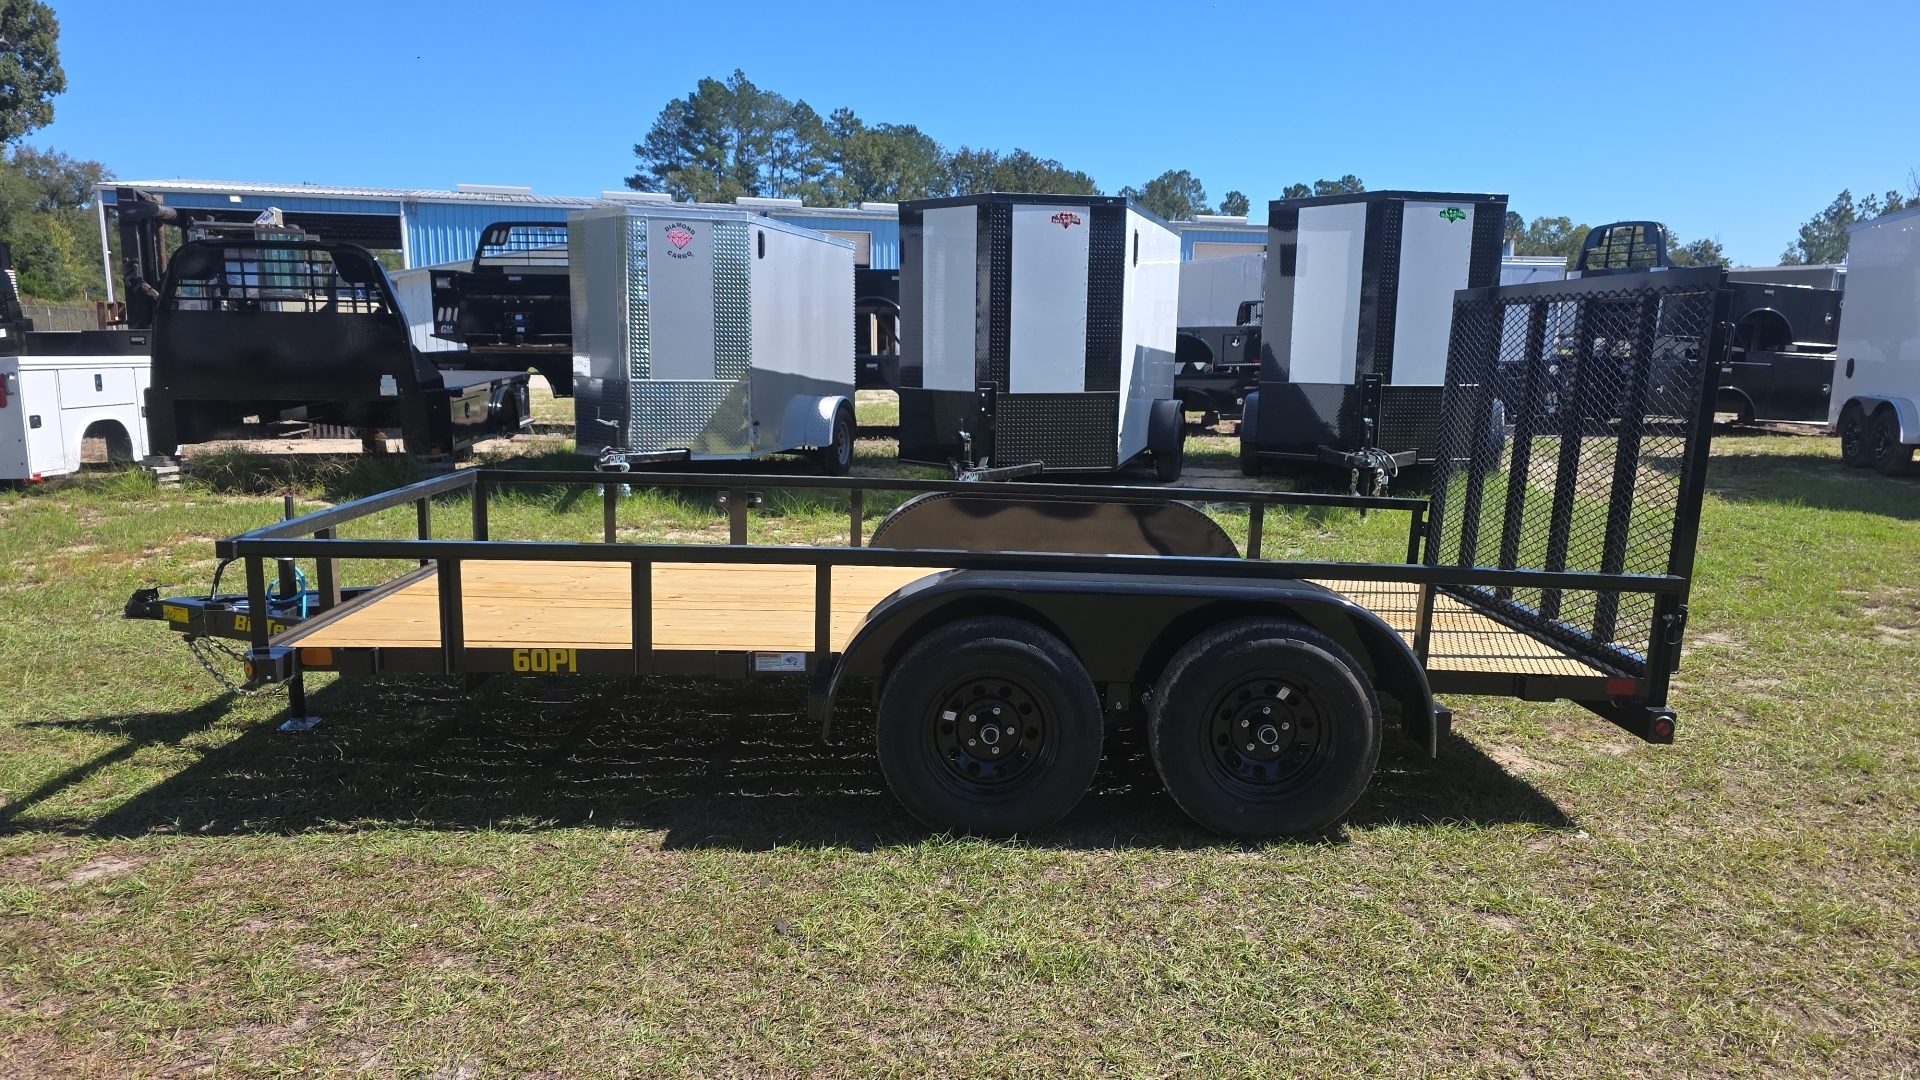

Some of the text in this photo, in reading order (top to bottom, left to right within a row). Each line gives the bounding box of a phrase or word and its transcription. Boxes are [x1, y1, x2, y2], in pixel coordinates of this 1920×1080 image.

[664, 222, 696, 235] DIAMOND
[667, 250, 692, 259] CARGO
[234, 614, 291, 635] Bi Te
[513, 648, 577, 673] 60PI
